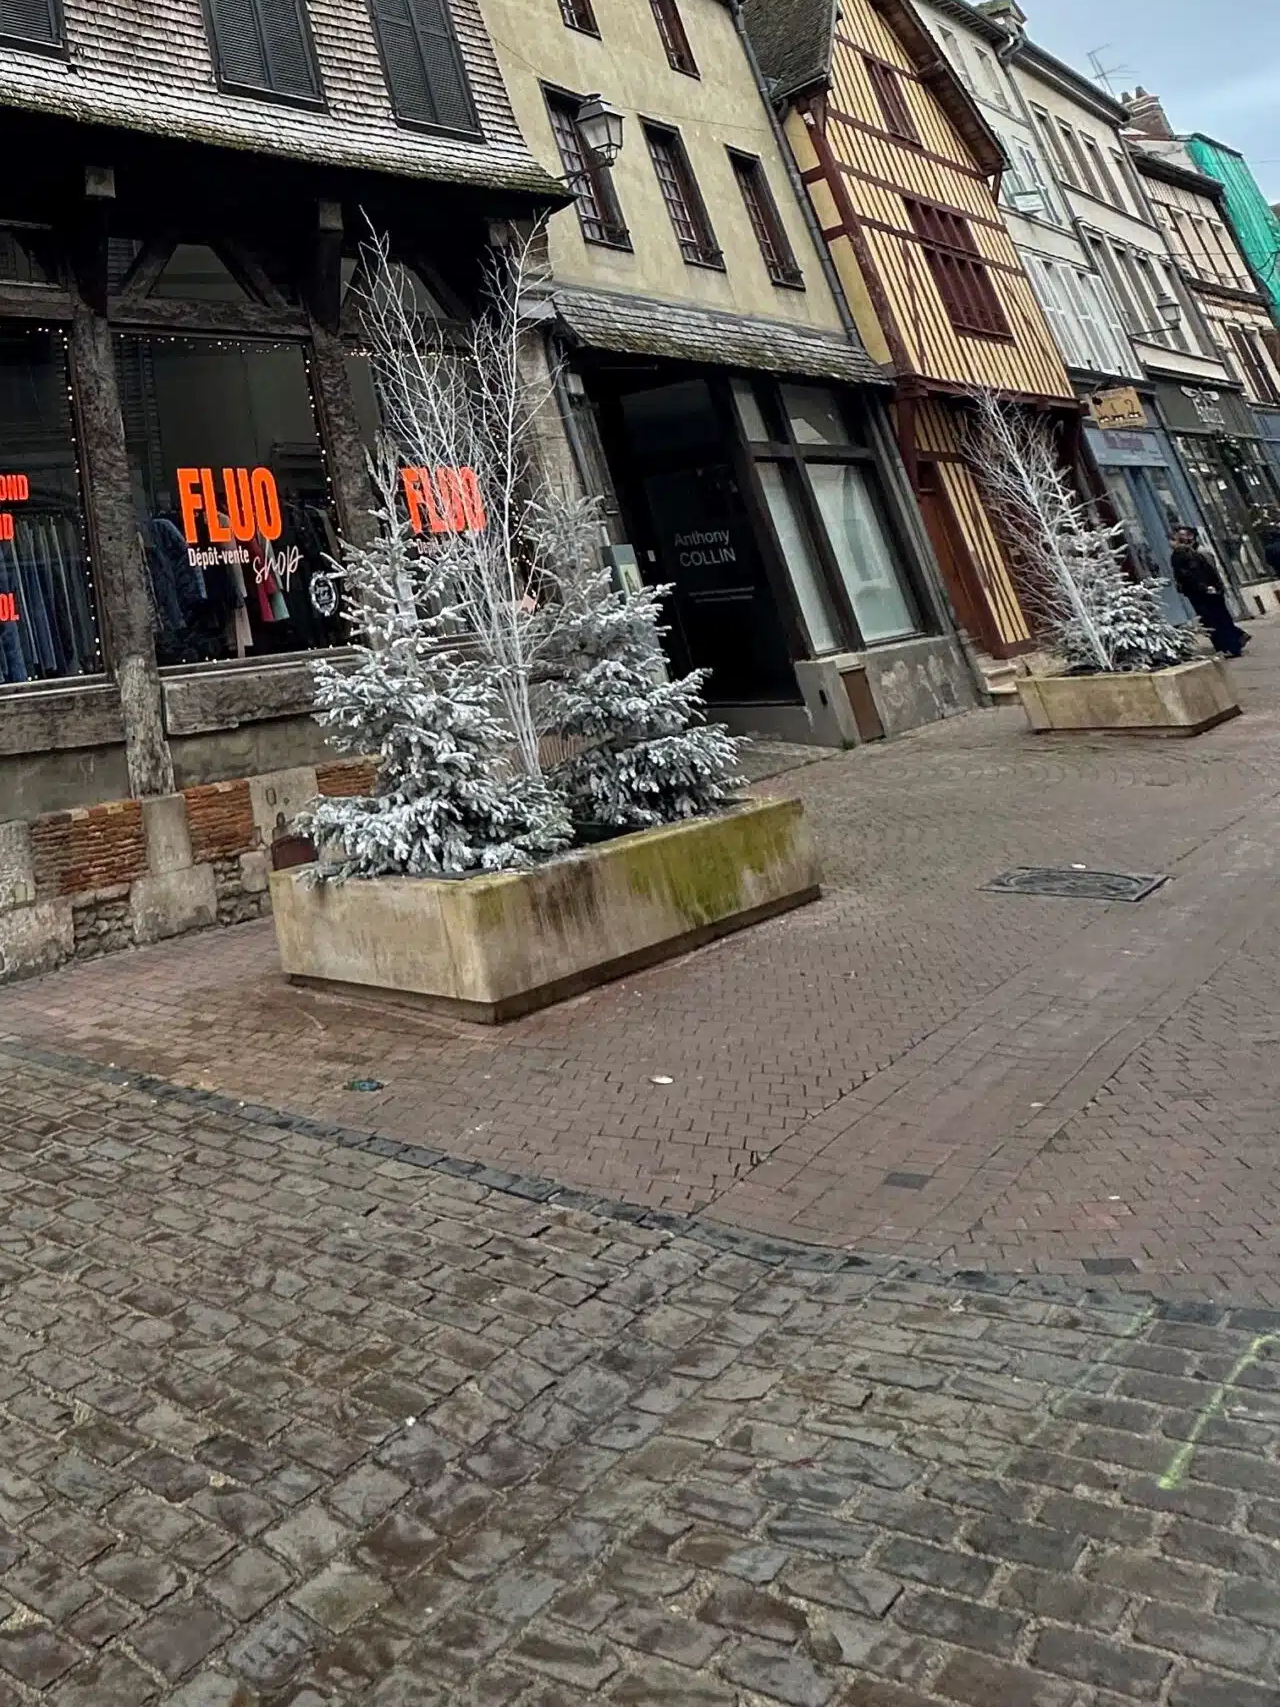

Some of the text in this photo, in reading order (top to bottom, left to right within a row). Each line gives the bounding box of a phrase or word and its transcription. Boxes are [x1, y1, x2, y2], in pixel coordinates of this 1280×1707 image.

[176, 467, 282, 544] FLUO
[399, 465, 487, 534] FLUO
[674, 529, 730, 547] Anthony
[679, 547, 737, 567] COLLIN
[187, 541, 304, 593] Dépôt-vente shop
